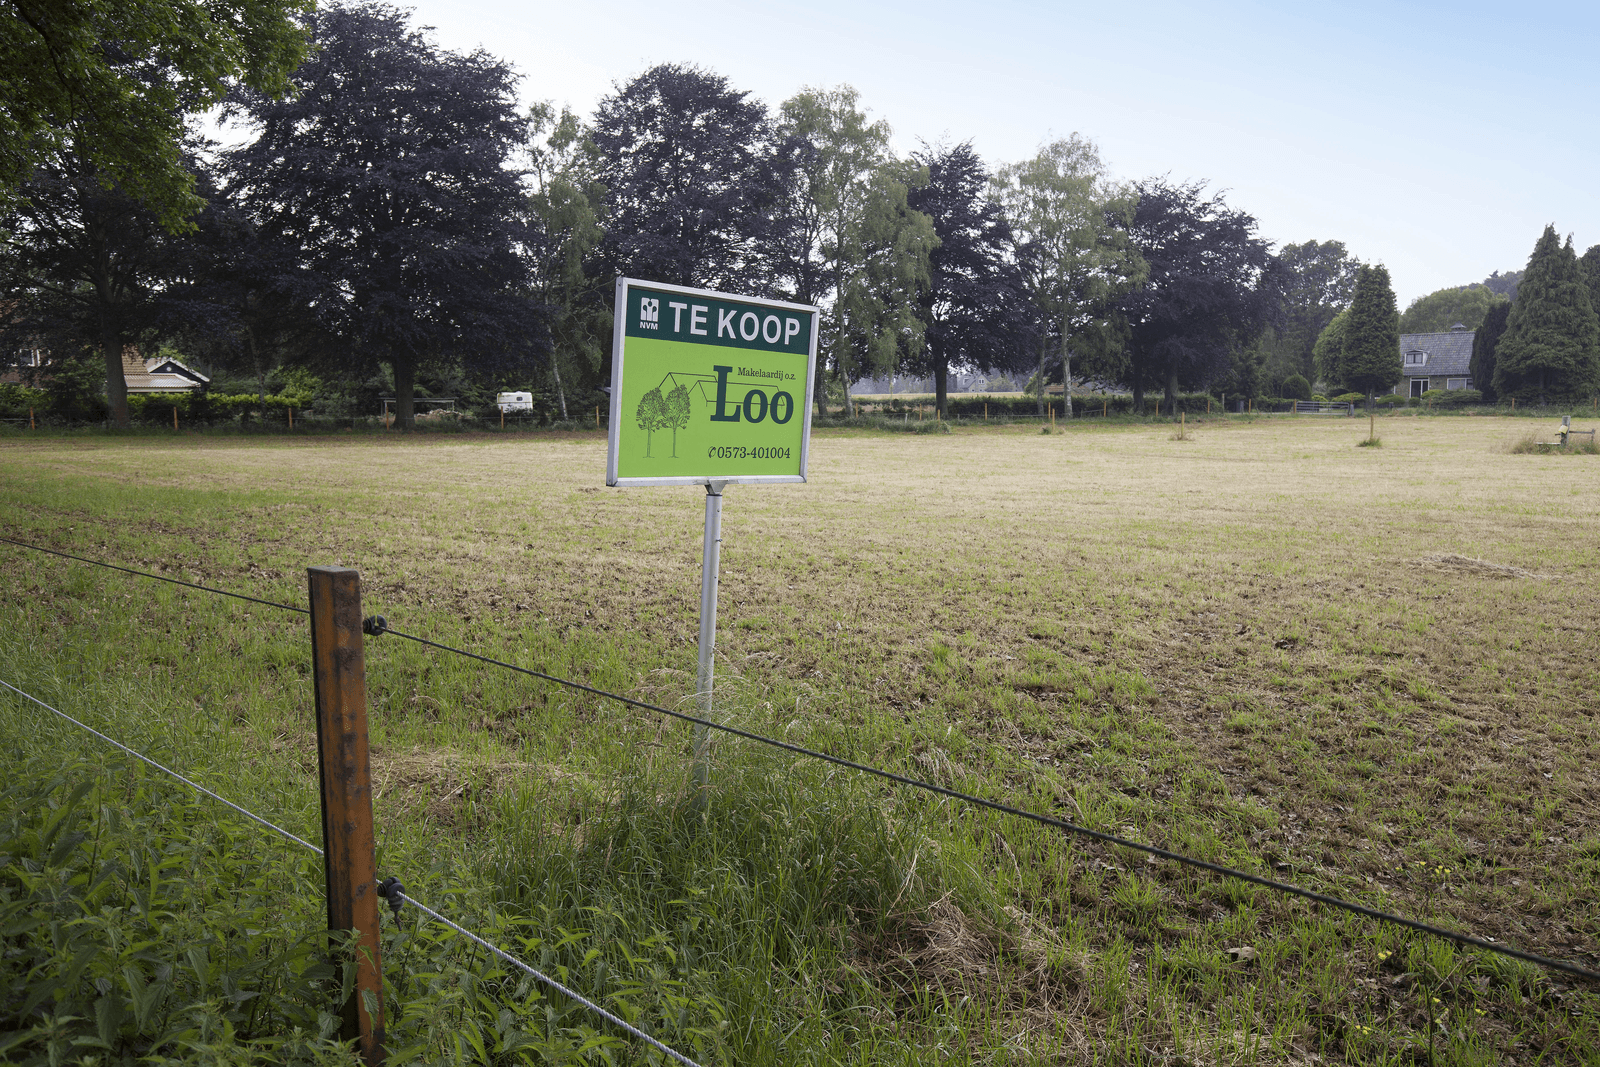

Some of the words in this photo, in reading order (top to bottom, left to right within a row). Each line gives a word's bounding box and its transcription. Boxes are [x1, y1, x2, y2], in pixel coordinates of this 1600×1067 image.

[639, 321, 659, 330] NVM
[669, 301, 709, 336] TE
[717, 308, 800, 345] KOOP
[737, 367, 784, 381] Makelaardij
[717, 446, 791, 459] 0573-401004
